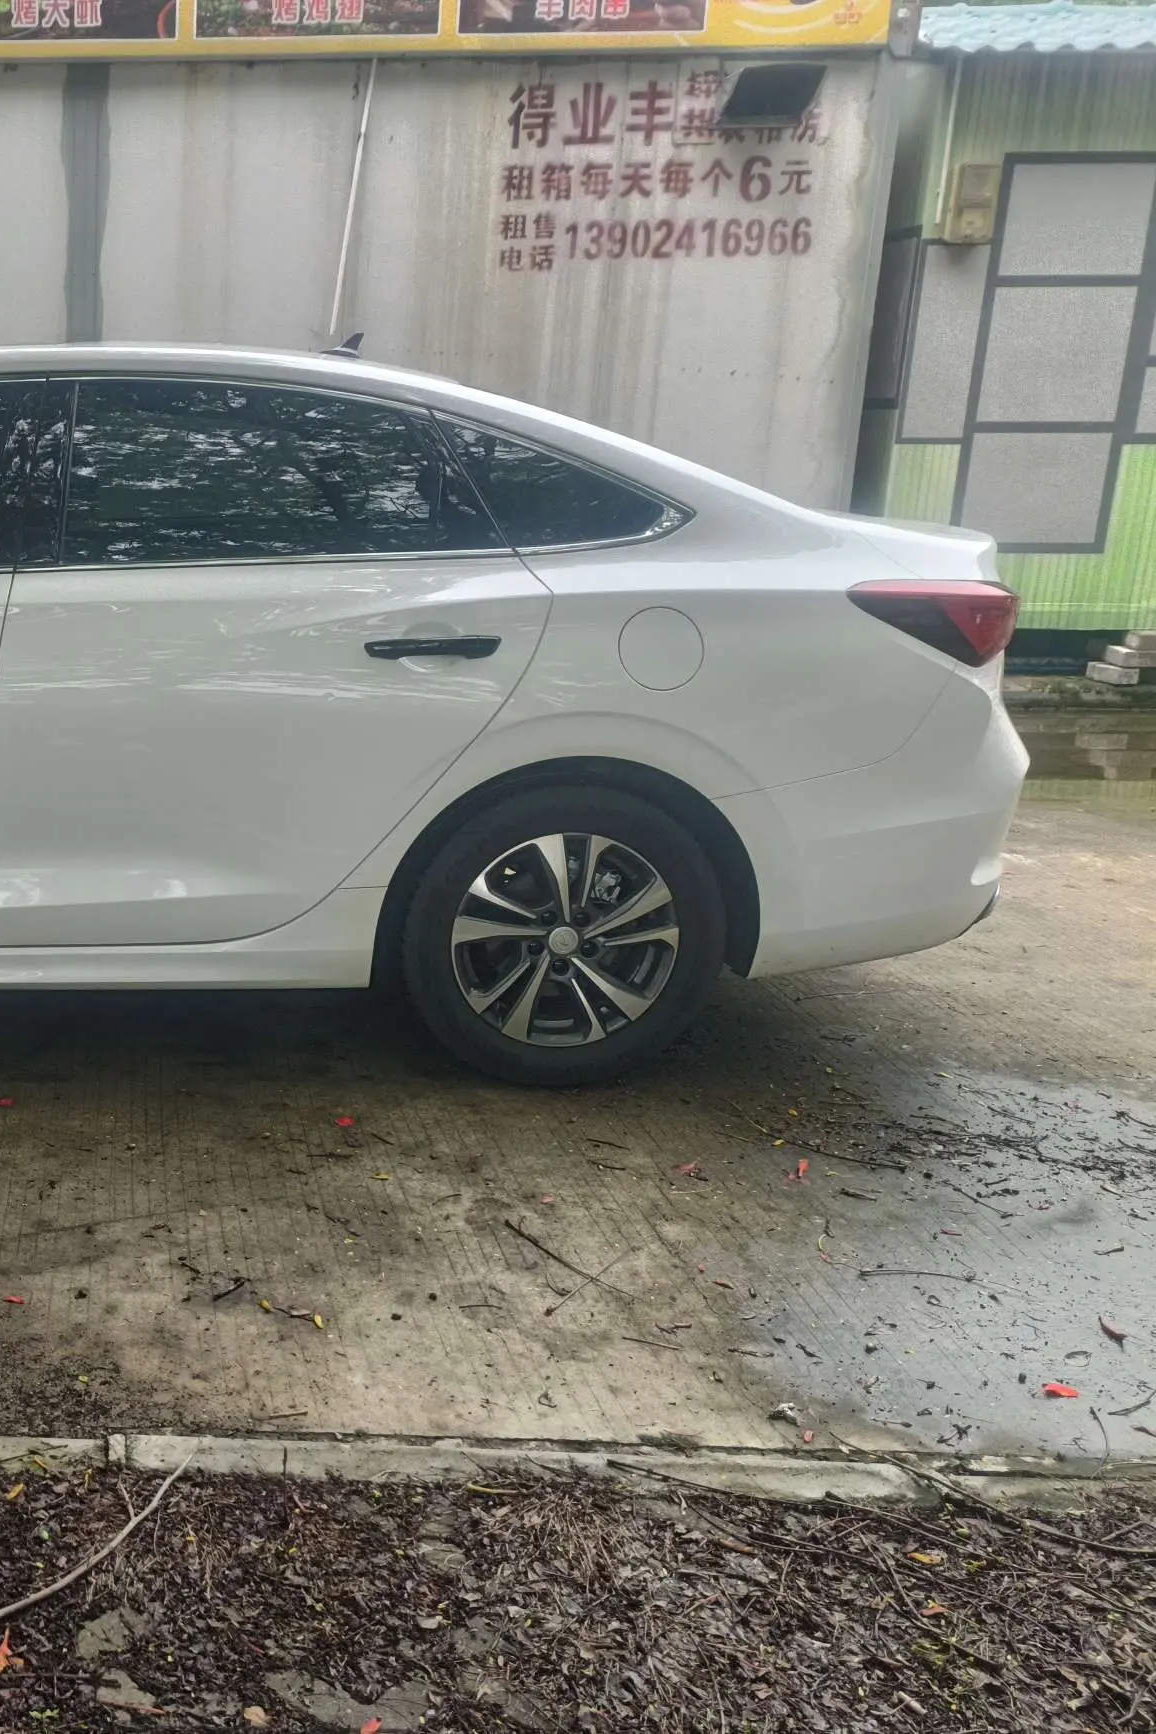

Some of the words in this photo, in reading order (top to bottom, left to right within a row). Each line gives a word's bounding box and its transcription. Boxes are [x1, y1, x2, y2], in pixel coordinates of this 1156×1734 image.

[11, 0, 102, 27] 烤大虾
[272, 0, 364, 24] 烤鸡翅
[500, 154, 814, 202] 租箱每天每个6元
[500, 212, 557, 241] 租售
[499, 244, 555, 272] 电话
[564, 215, 813, 261] 13902416966
